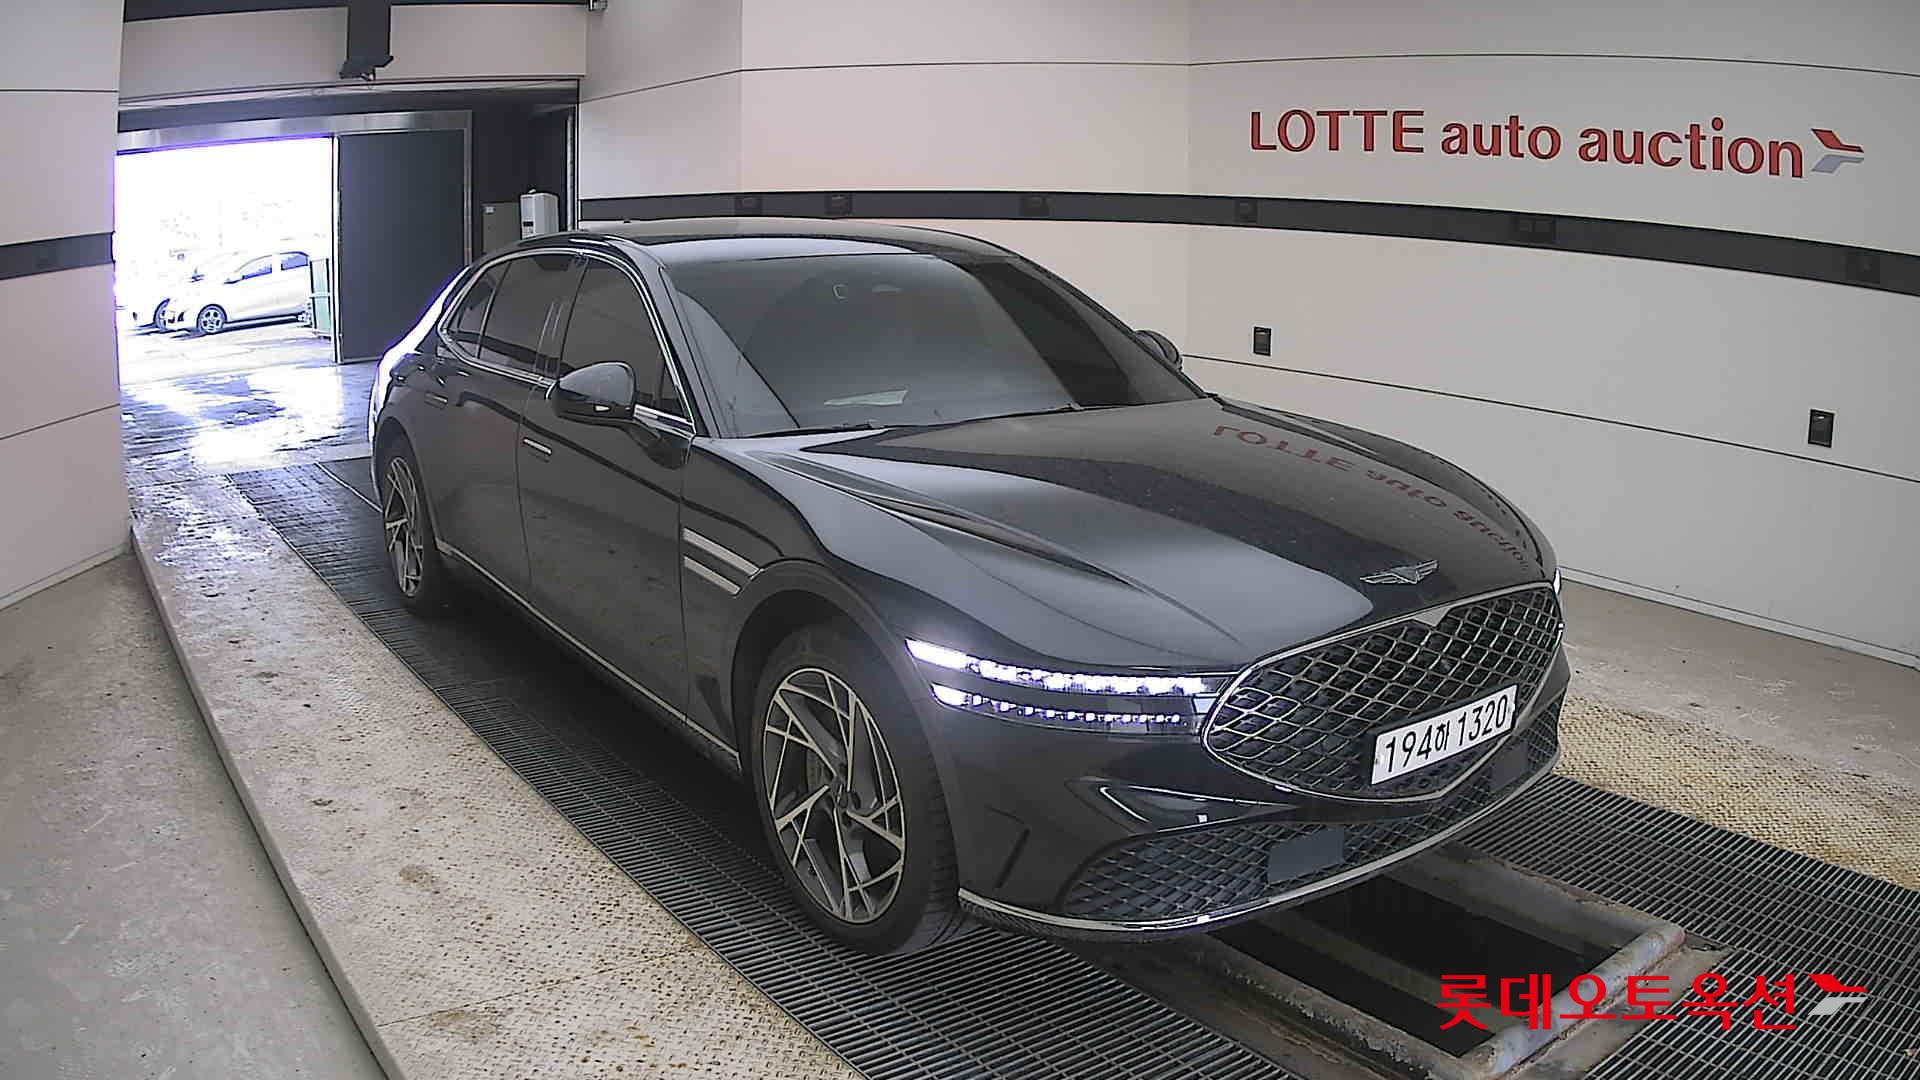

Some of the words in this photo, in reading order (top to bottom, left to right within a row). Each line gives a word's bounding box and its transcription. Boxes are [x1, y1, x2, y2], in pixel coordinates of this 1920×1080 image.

[1249, 109, 1425, 154] LOTTE
[1440, 115, 1562, 160] auto
[1577, 116, 1803, 178] auction
[1385, 720, 1450, 773] 194하
[1458, 694, 1508, 747] 1320
